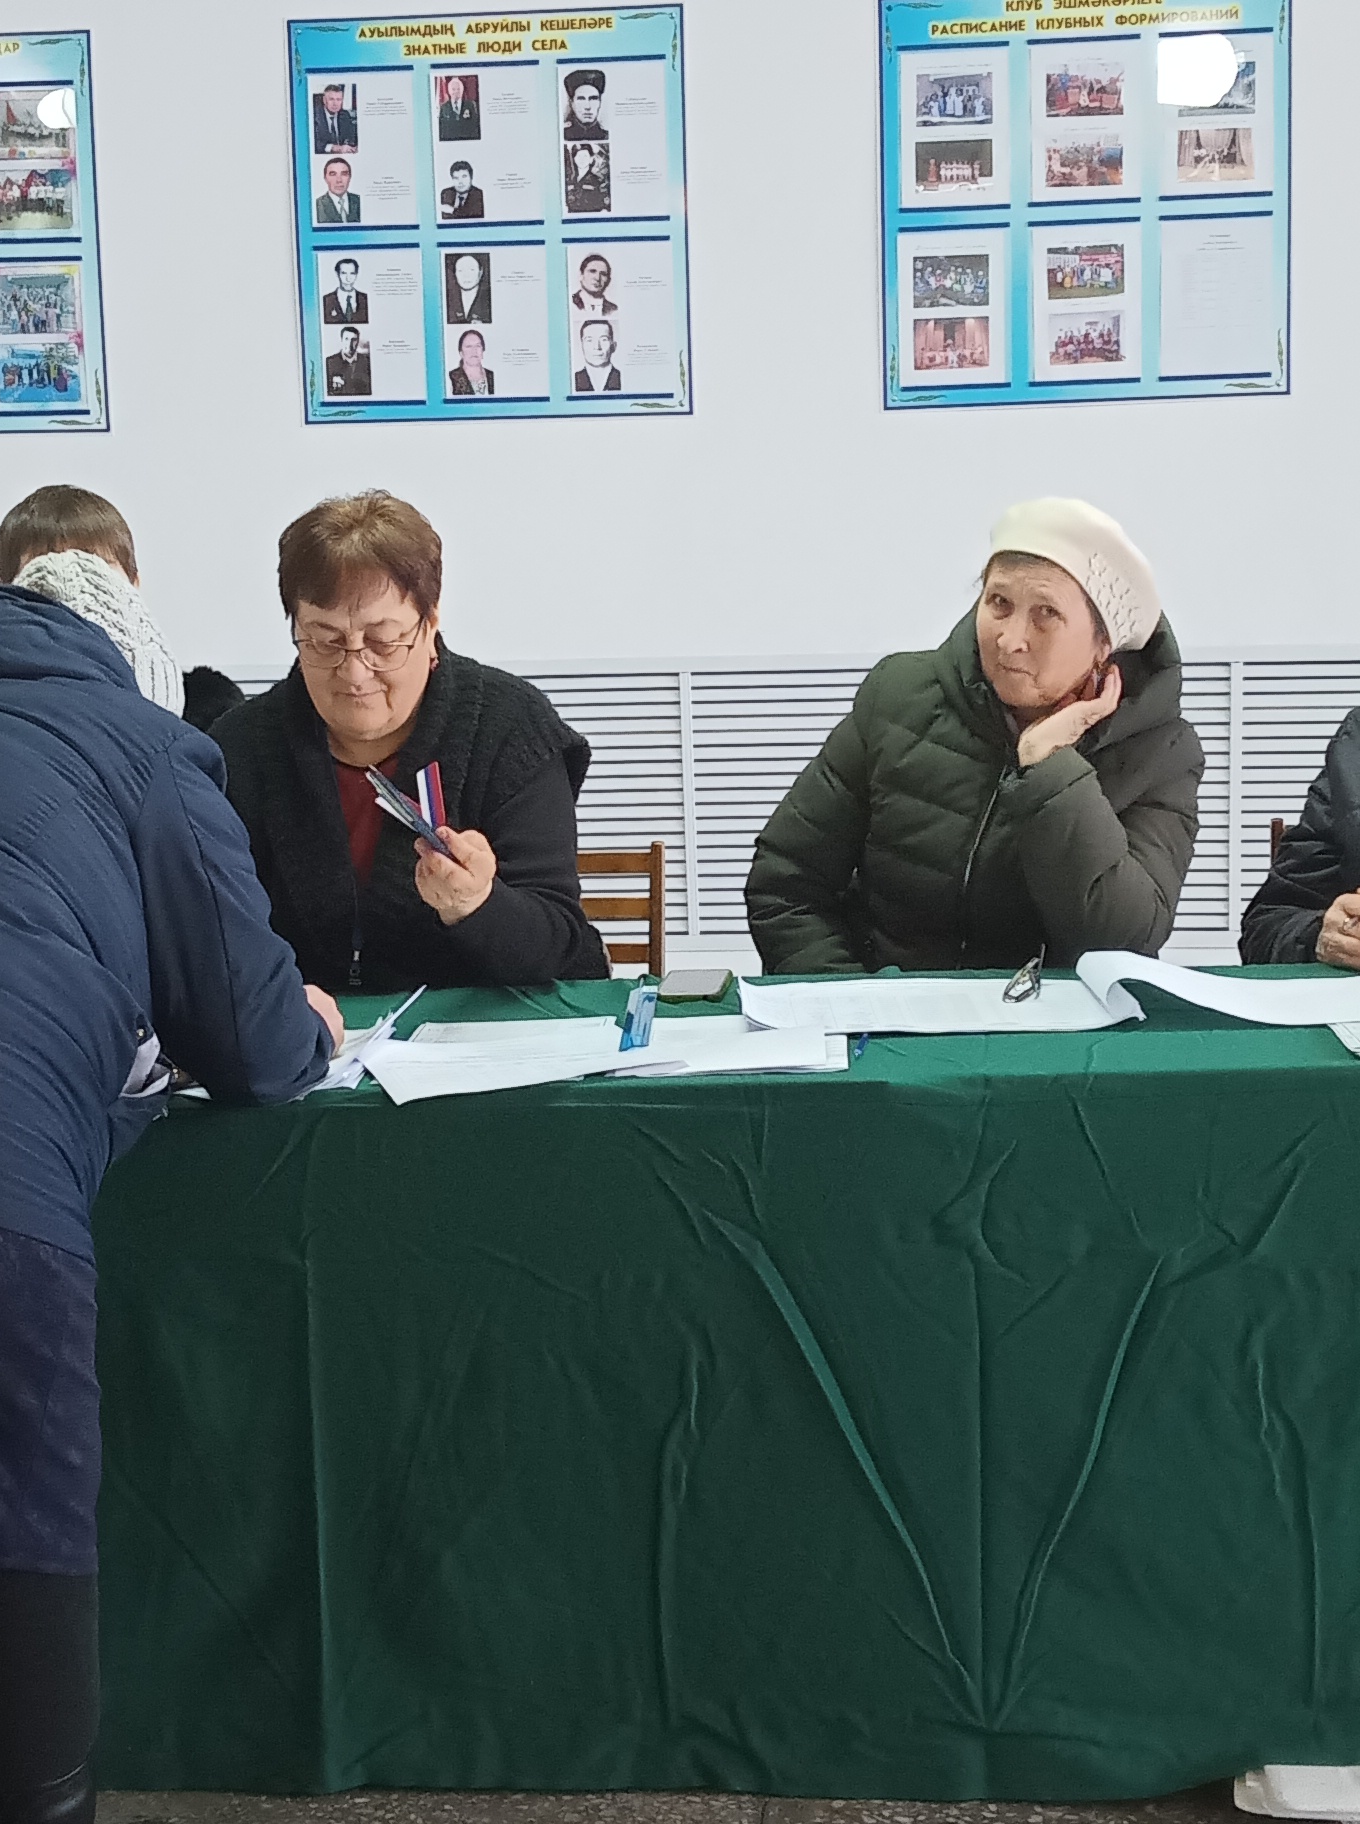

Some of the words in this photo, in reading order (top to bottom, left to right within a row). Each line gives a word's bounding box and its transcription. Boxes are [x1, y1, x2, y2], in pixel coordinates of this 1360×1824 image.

[1005, 0, 1043, 12] КЛУБ
[1053, 0, 1163, 10] ЭШМӘКӘР
[358, 23, 456, 39] АУЫЛЫМДЫҢ
[465, 19, 531, 34] АБРУЙЛЫ
[540, 17, 613, 31] КЕШЕЛӘРЕ
[931, 20, 1026, 35] РАСПИСАНИЕ
[1035, 15, 1105, 30] КЛУБНЫХ
[1115, 8, 1239, 26] ФОРМИРОВАНИЙ
[403, 42, 467, 56] ЗНАТНЫЕ
[476, 40, 522, 54] ЛЮДИ
[531, 39, 568, 51] СЕЛА
